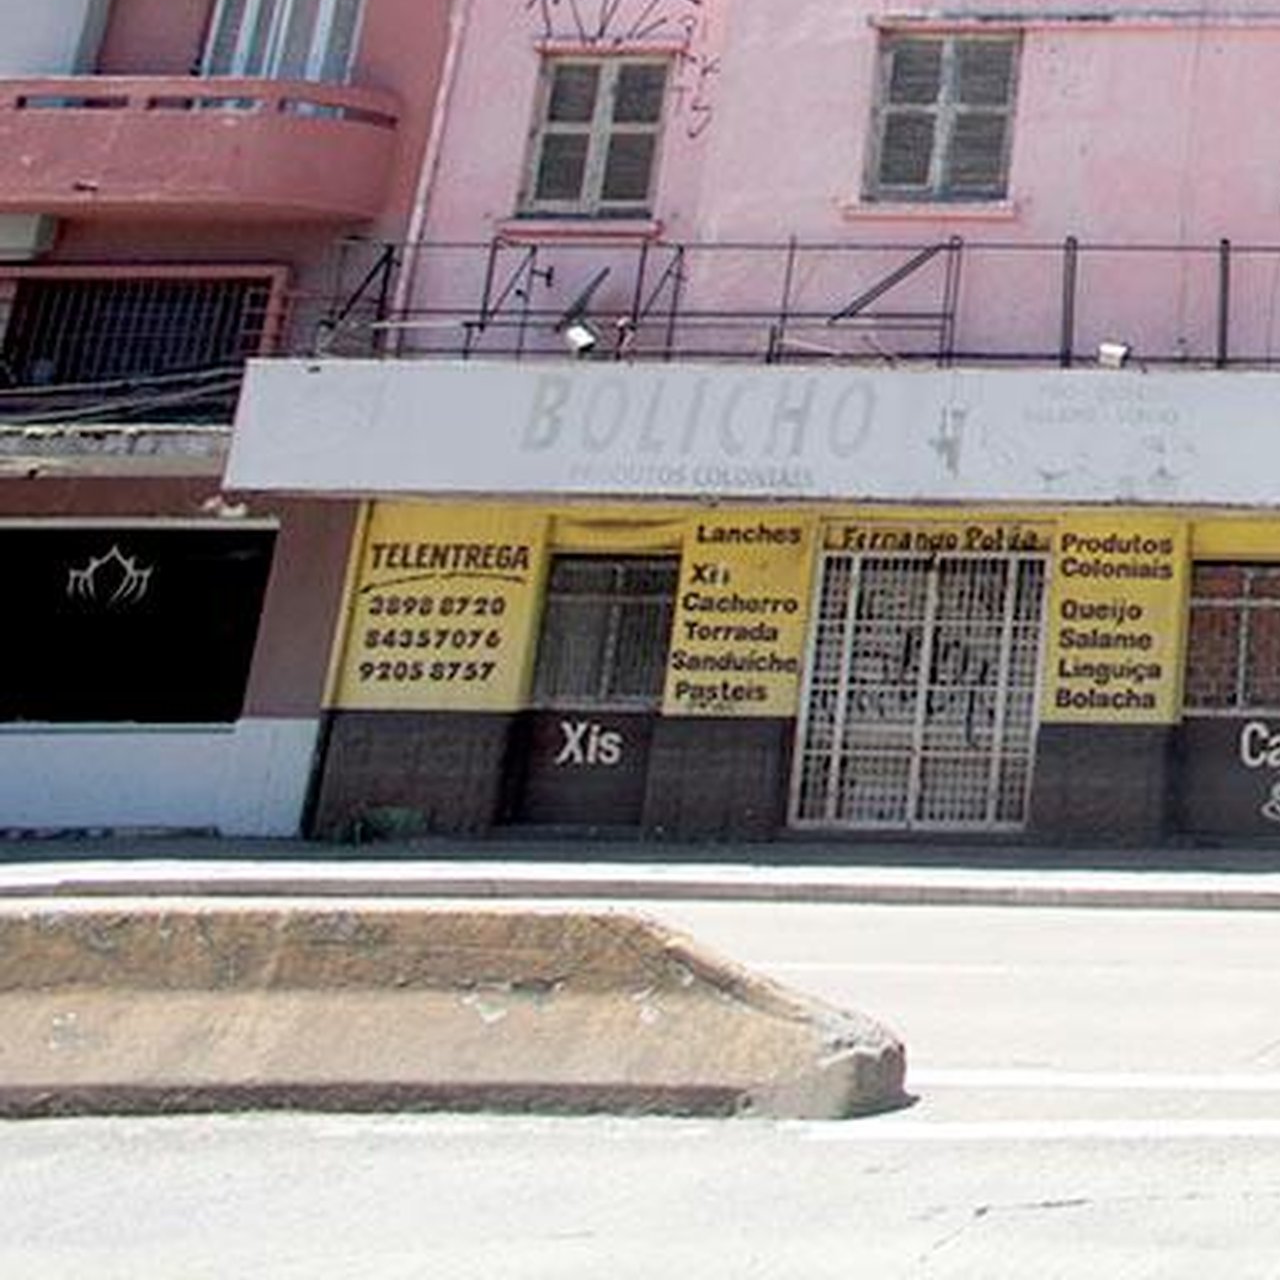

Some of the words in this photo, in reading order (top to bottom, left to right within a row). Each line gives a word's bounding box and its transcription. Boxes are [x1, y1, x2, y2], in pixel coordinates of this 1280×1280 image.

[520, 373, 878, 458] BOLICHO
[696, 524, 802, 546] Lanches
[1061, 533, 1174, 555] Produtos
[371, 543, 530, 570] TELENTREGA
[1061, 557, 1173, 579] Coloniais
[682, 592, 798, 615] Cachorro
[1061, 598, 1143, 626] Queijo
[684, 622, 780, 642] Torrada
[1058, 627, 1153, 651] Salame
[1058, 658, 1162, 686] Linguiça
[1055, 688, 1157, 710] Bolacha
[554, 721, 624, 765] Xis
